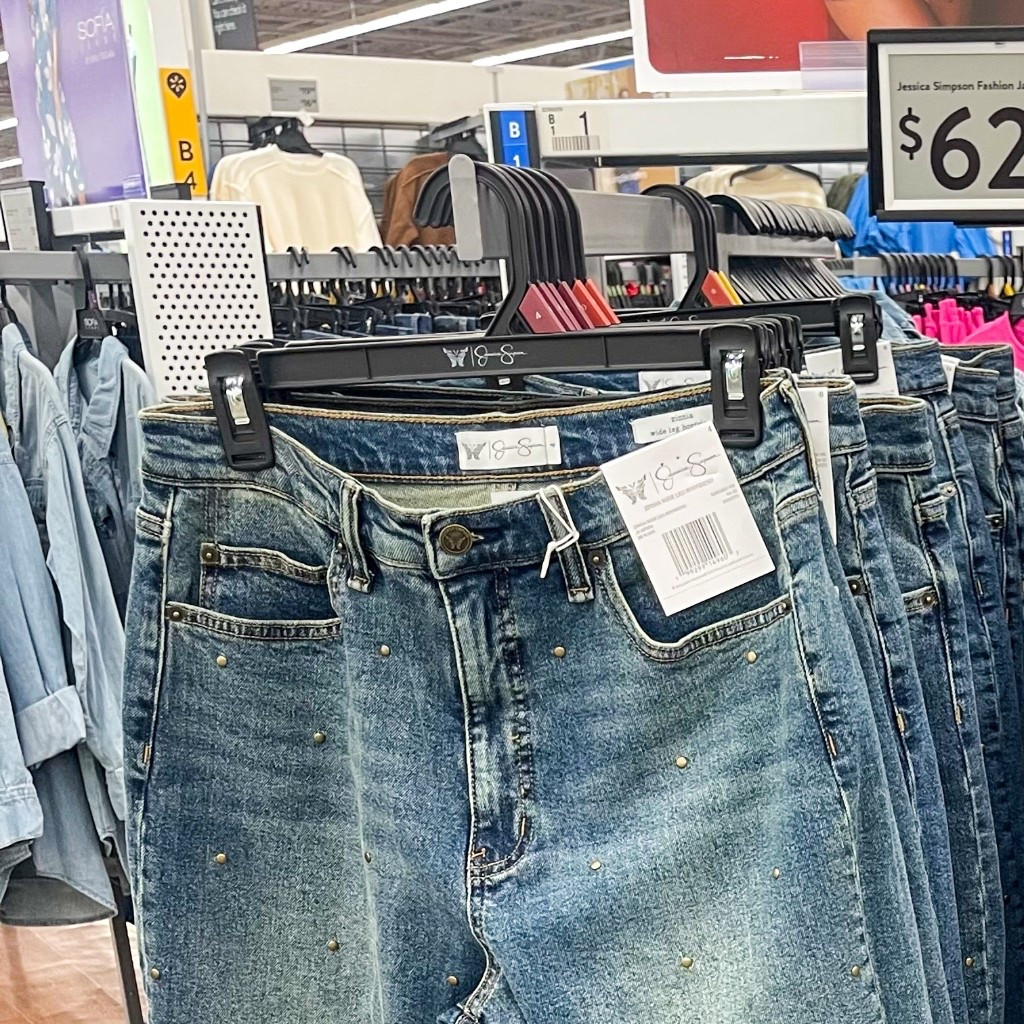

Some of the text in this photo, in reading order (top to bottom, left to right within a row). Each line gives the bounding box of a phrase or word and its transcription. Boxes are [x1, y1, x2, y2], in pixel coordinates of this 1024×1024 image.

[897, 82, 930, 91] Jessica
[933, 81, 974, 93] Simpson
[977, 80, 1014, 90] Fashion
[548, 114, 555, 124] B
[578, 111, 588, 136] 1
[509, 121, 521, 139] B
[179, 141, 193, 161] B
[184, 171, 197, 190] 4
[650, 427, 667, 436] wide
[669, 425, 680, 434] leg
